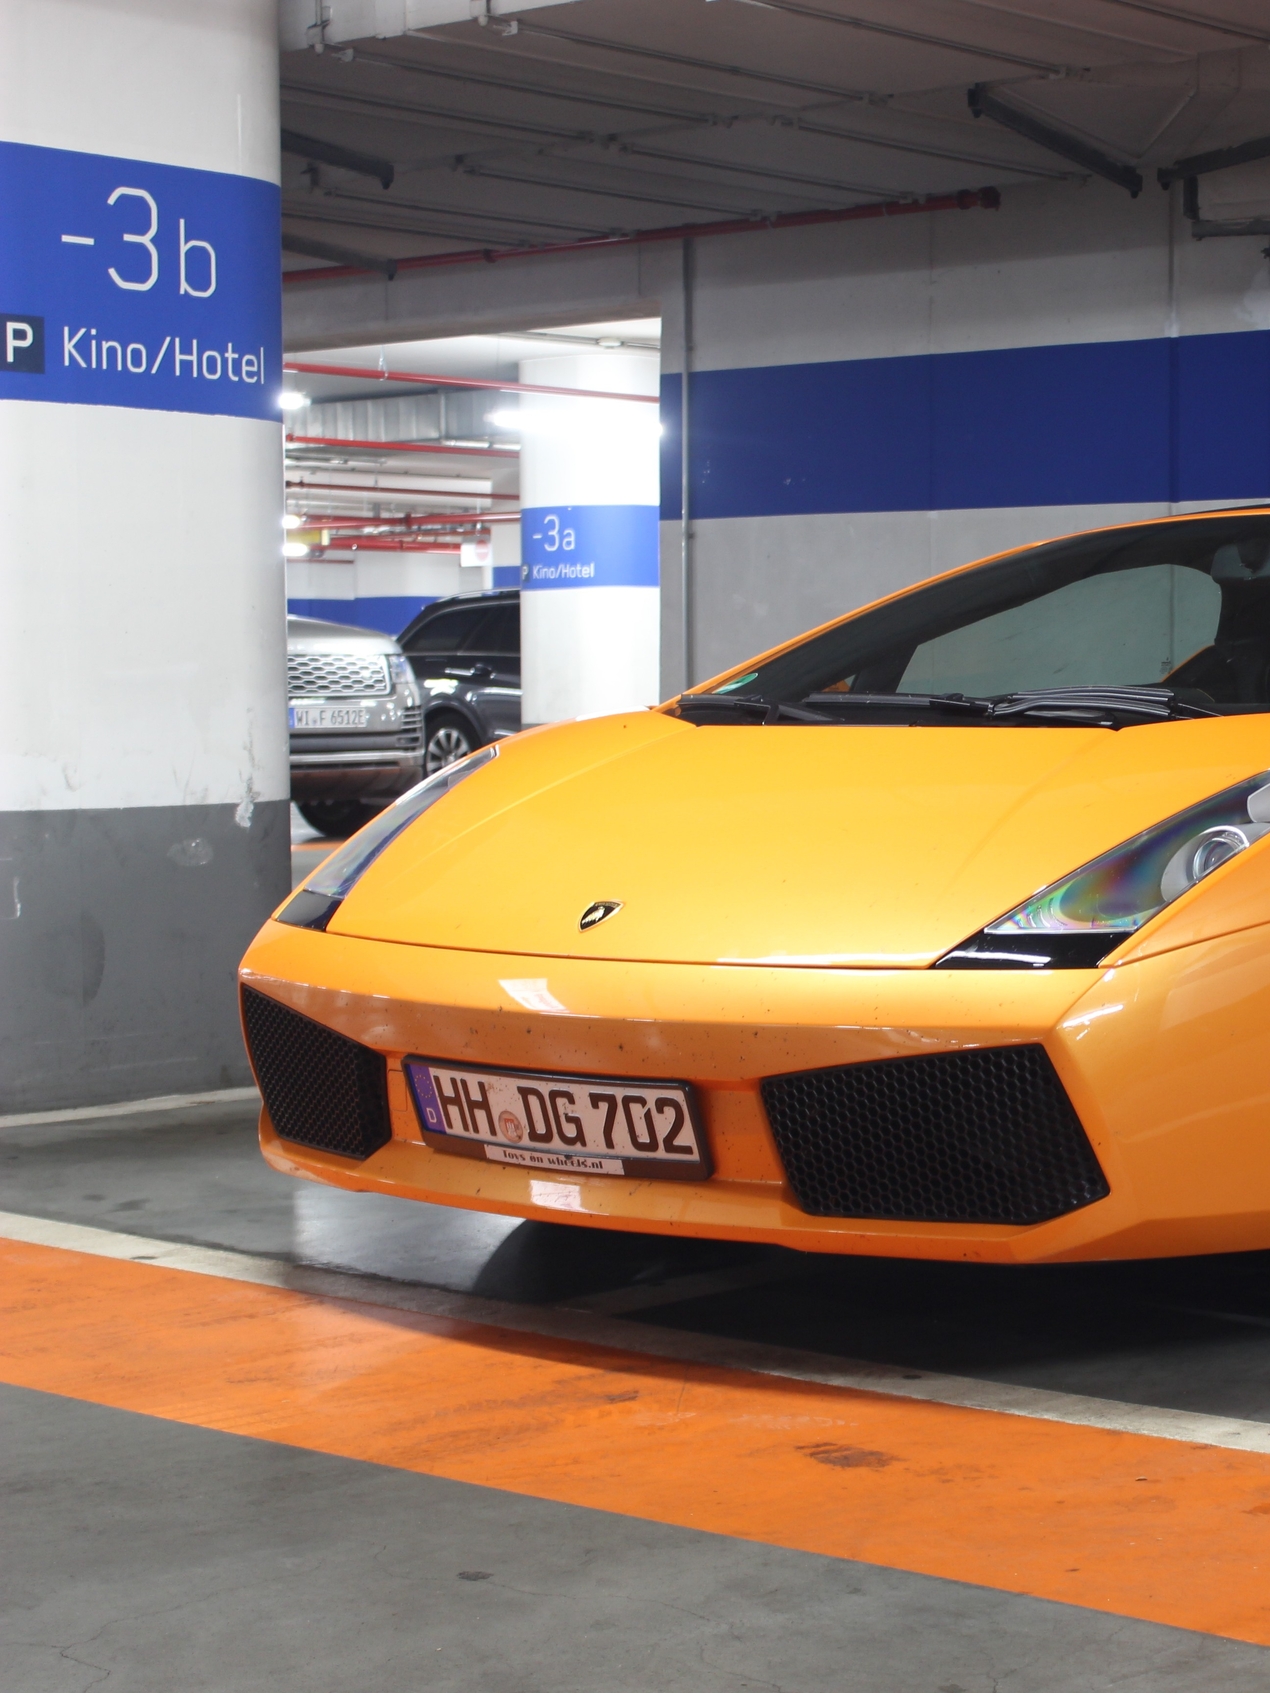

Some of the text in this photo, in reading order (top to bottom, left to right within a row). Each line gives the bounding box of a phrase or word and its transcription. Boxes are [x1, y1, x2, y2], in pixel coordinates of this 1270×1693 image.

[61, 186, 216, 298] -3b
[6, 321, 265, 385] P Kino/Hotel
[532, 514, 576, 552] -3a
[522, 562, 595, 580] P Kino/Hotel
[295, 711, 309, 726] WI
[319, 710, 327, 726] F
[427, 1107, 437, 1123] D
[433, 1075, 693, 1155] HH DG 702
